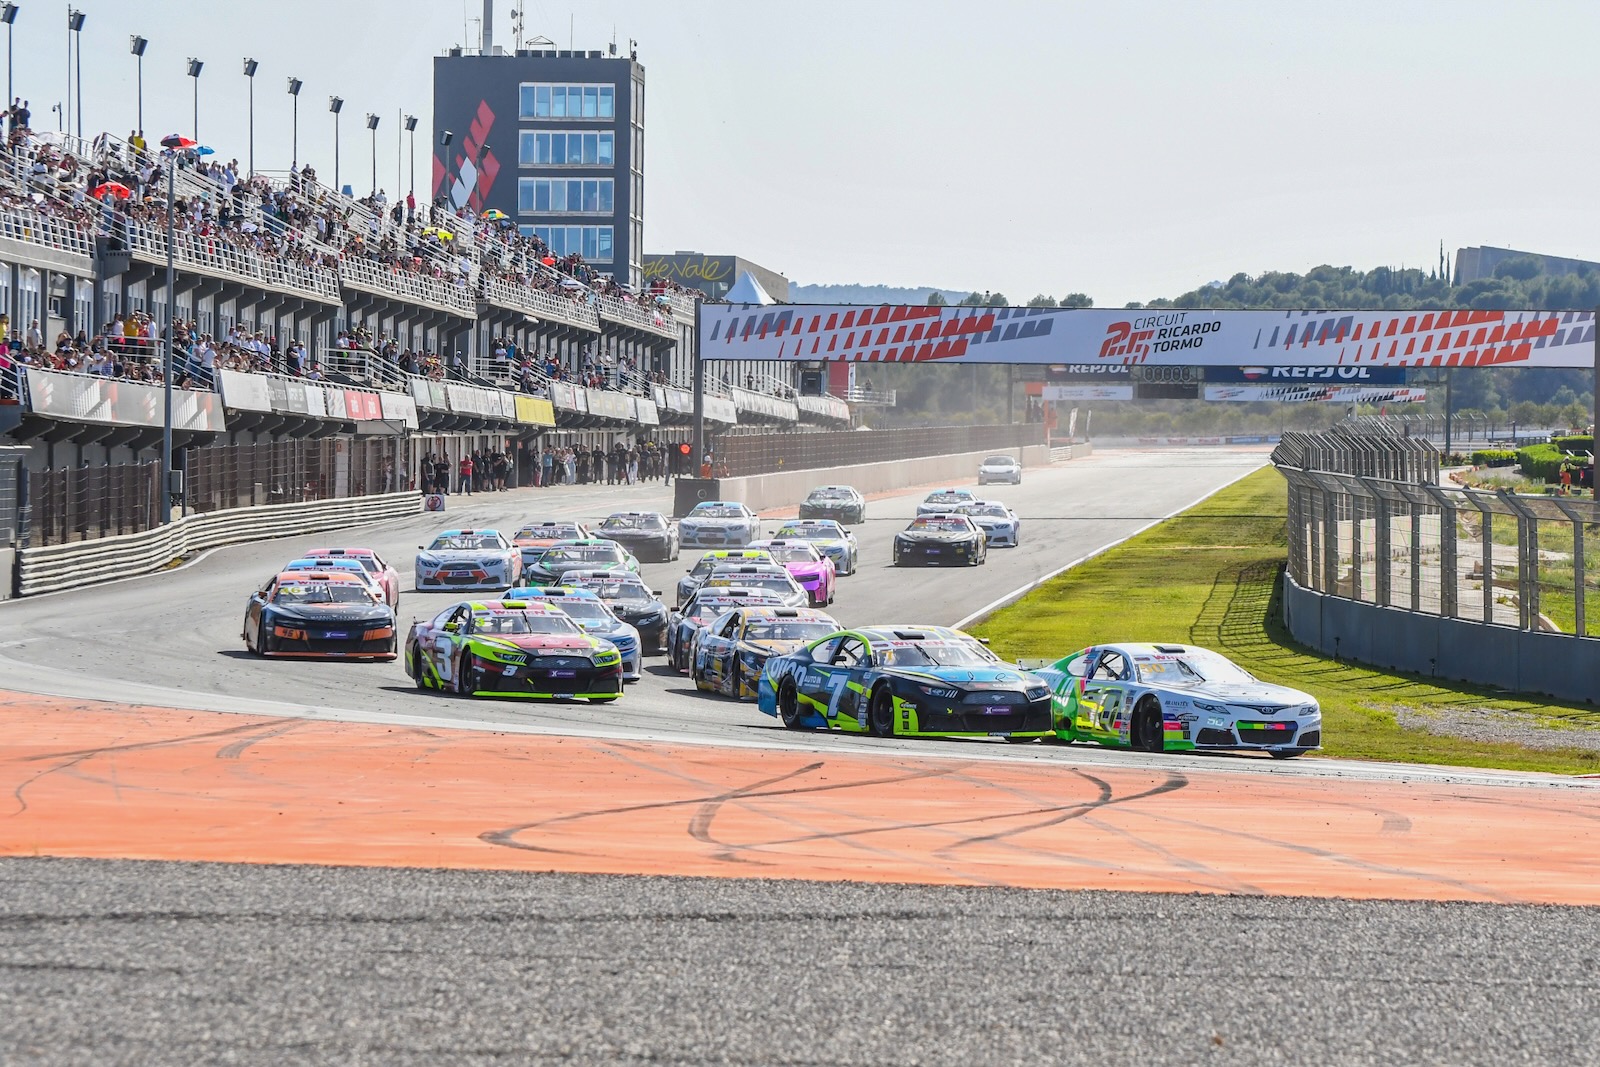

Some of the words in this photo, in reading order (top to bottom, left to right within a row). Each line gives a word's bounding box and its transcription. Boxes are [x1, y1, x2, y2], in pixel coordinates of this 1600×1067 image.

[1134, 312, 1188, 330] CIRCUIT
[1157, 321, 1221, 339] RICARDO
[1153, 337, 1203, 353] TORMO
[502, 665, 518, 676] 3
[826, 673, 849, 717] 7
